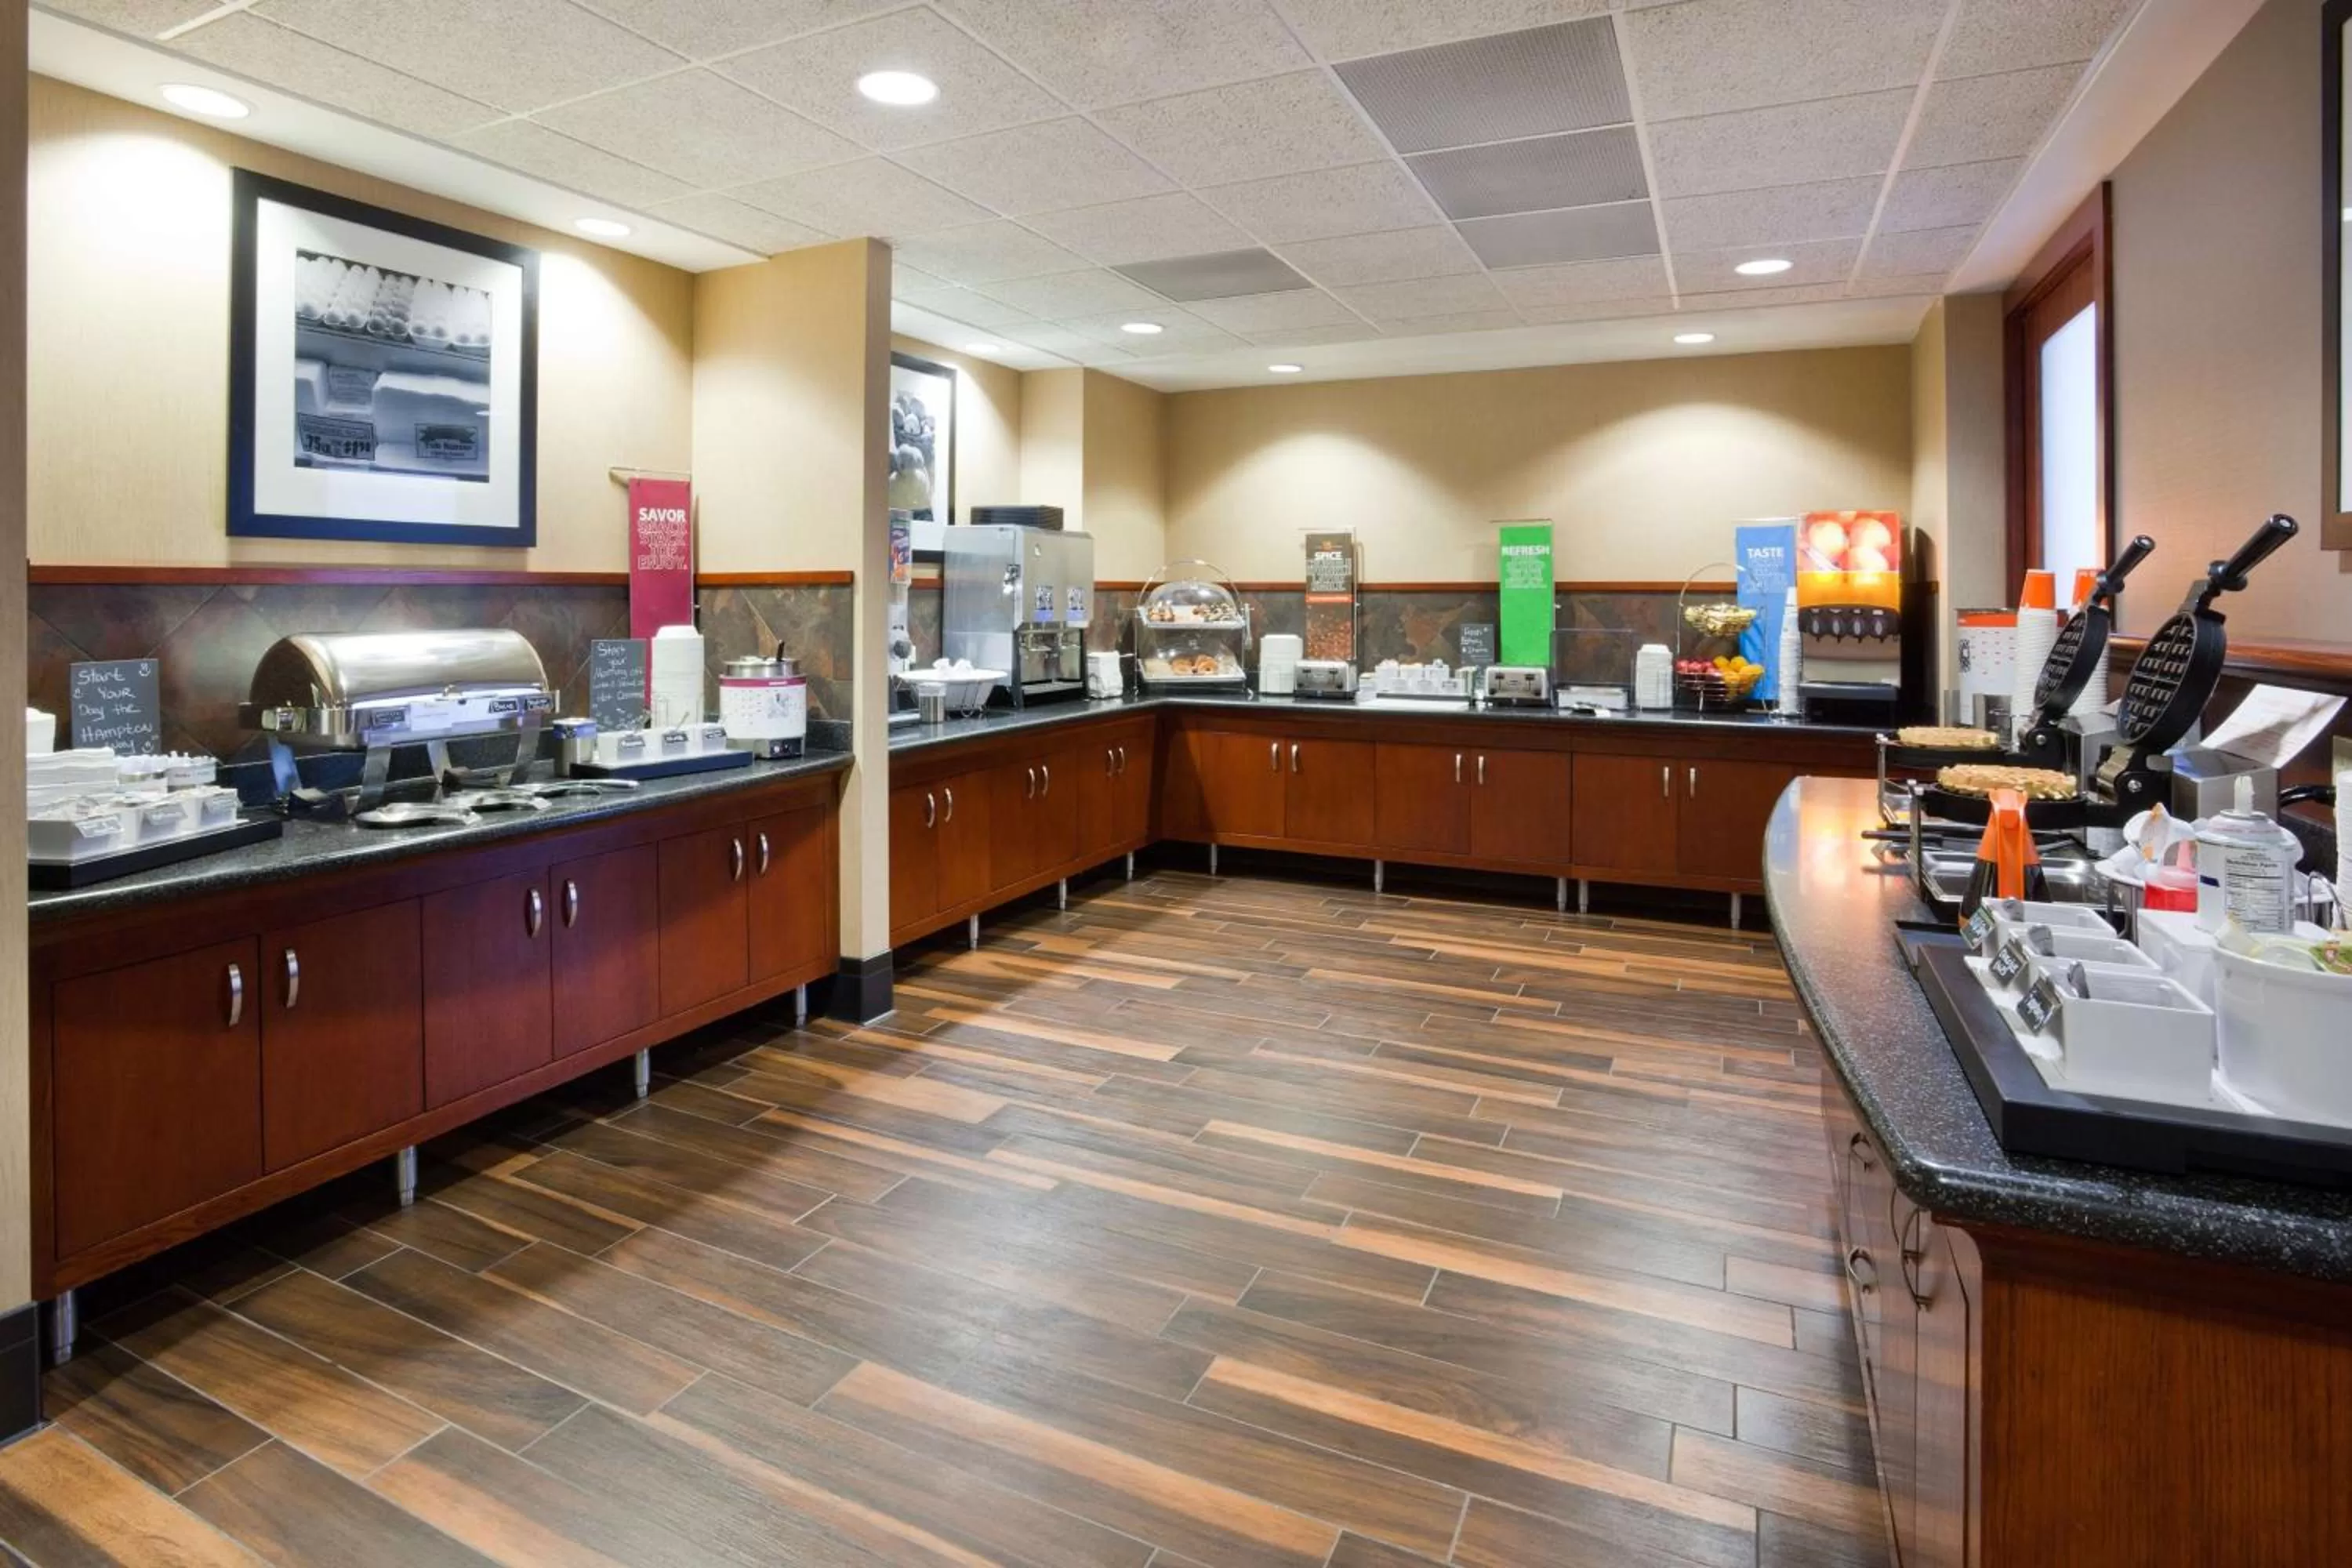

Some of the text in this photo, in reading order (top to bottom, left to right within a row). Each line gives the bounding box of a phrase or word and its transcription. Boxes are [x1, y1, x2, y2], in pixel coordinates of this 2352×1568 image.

[639, 507, 686, 523] SAVOR
[1314, 551, 1343, 561] SPICE
[1501, 545, 1550, 556] REFRESH
[1747, 546, 1785, 559] TASTE
[597, 642, 626, 657] Start
[77, 667, 126, 686] Start
[78, 704, 142, 722] Day the
